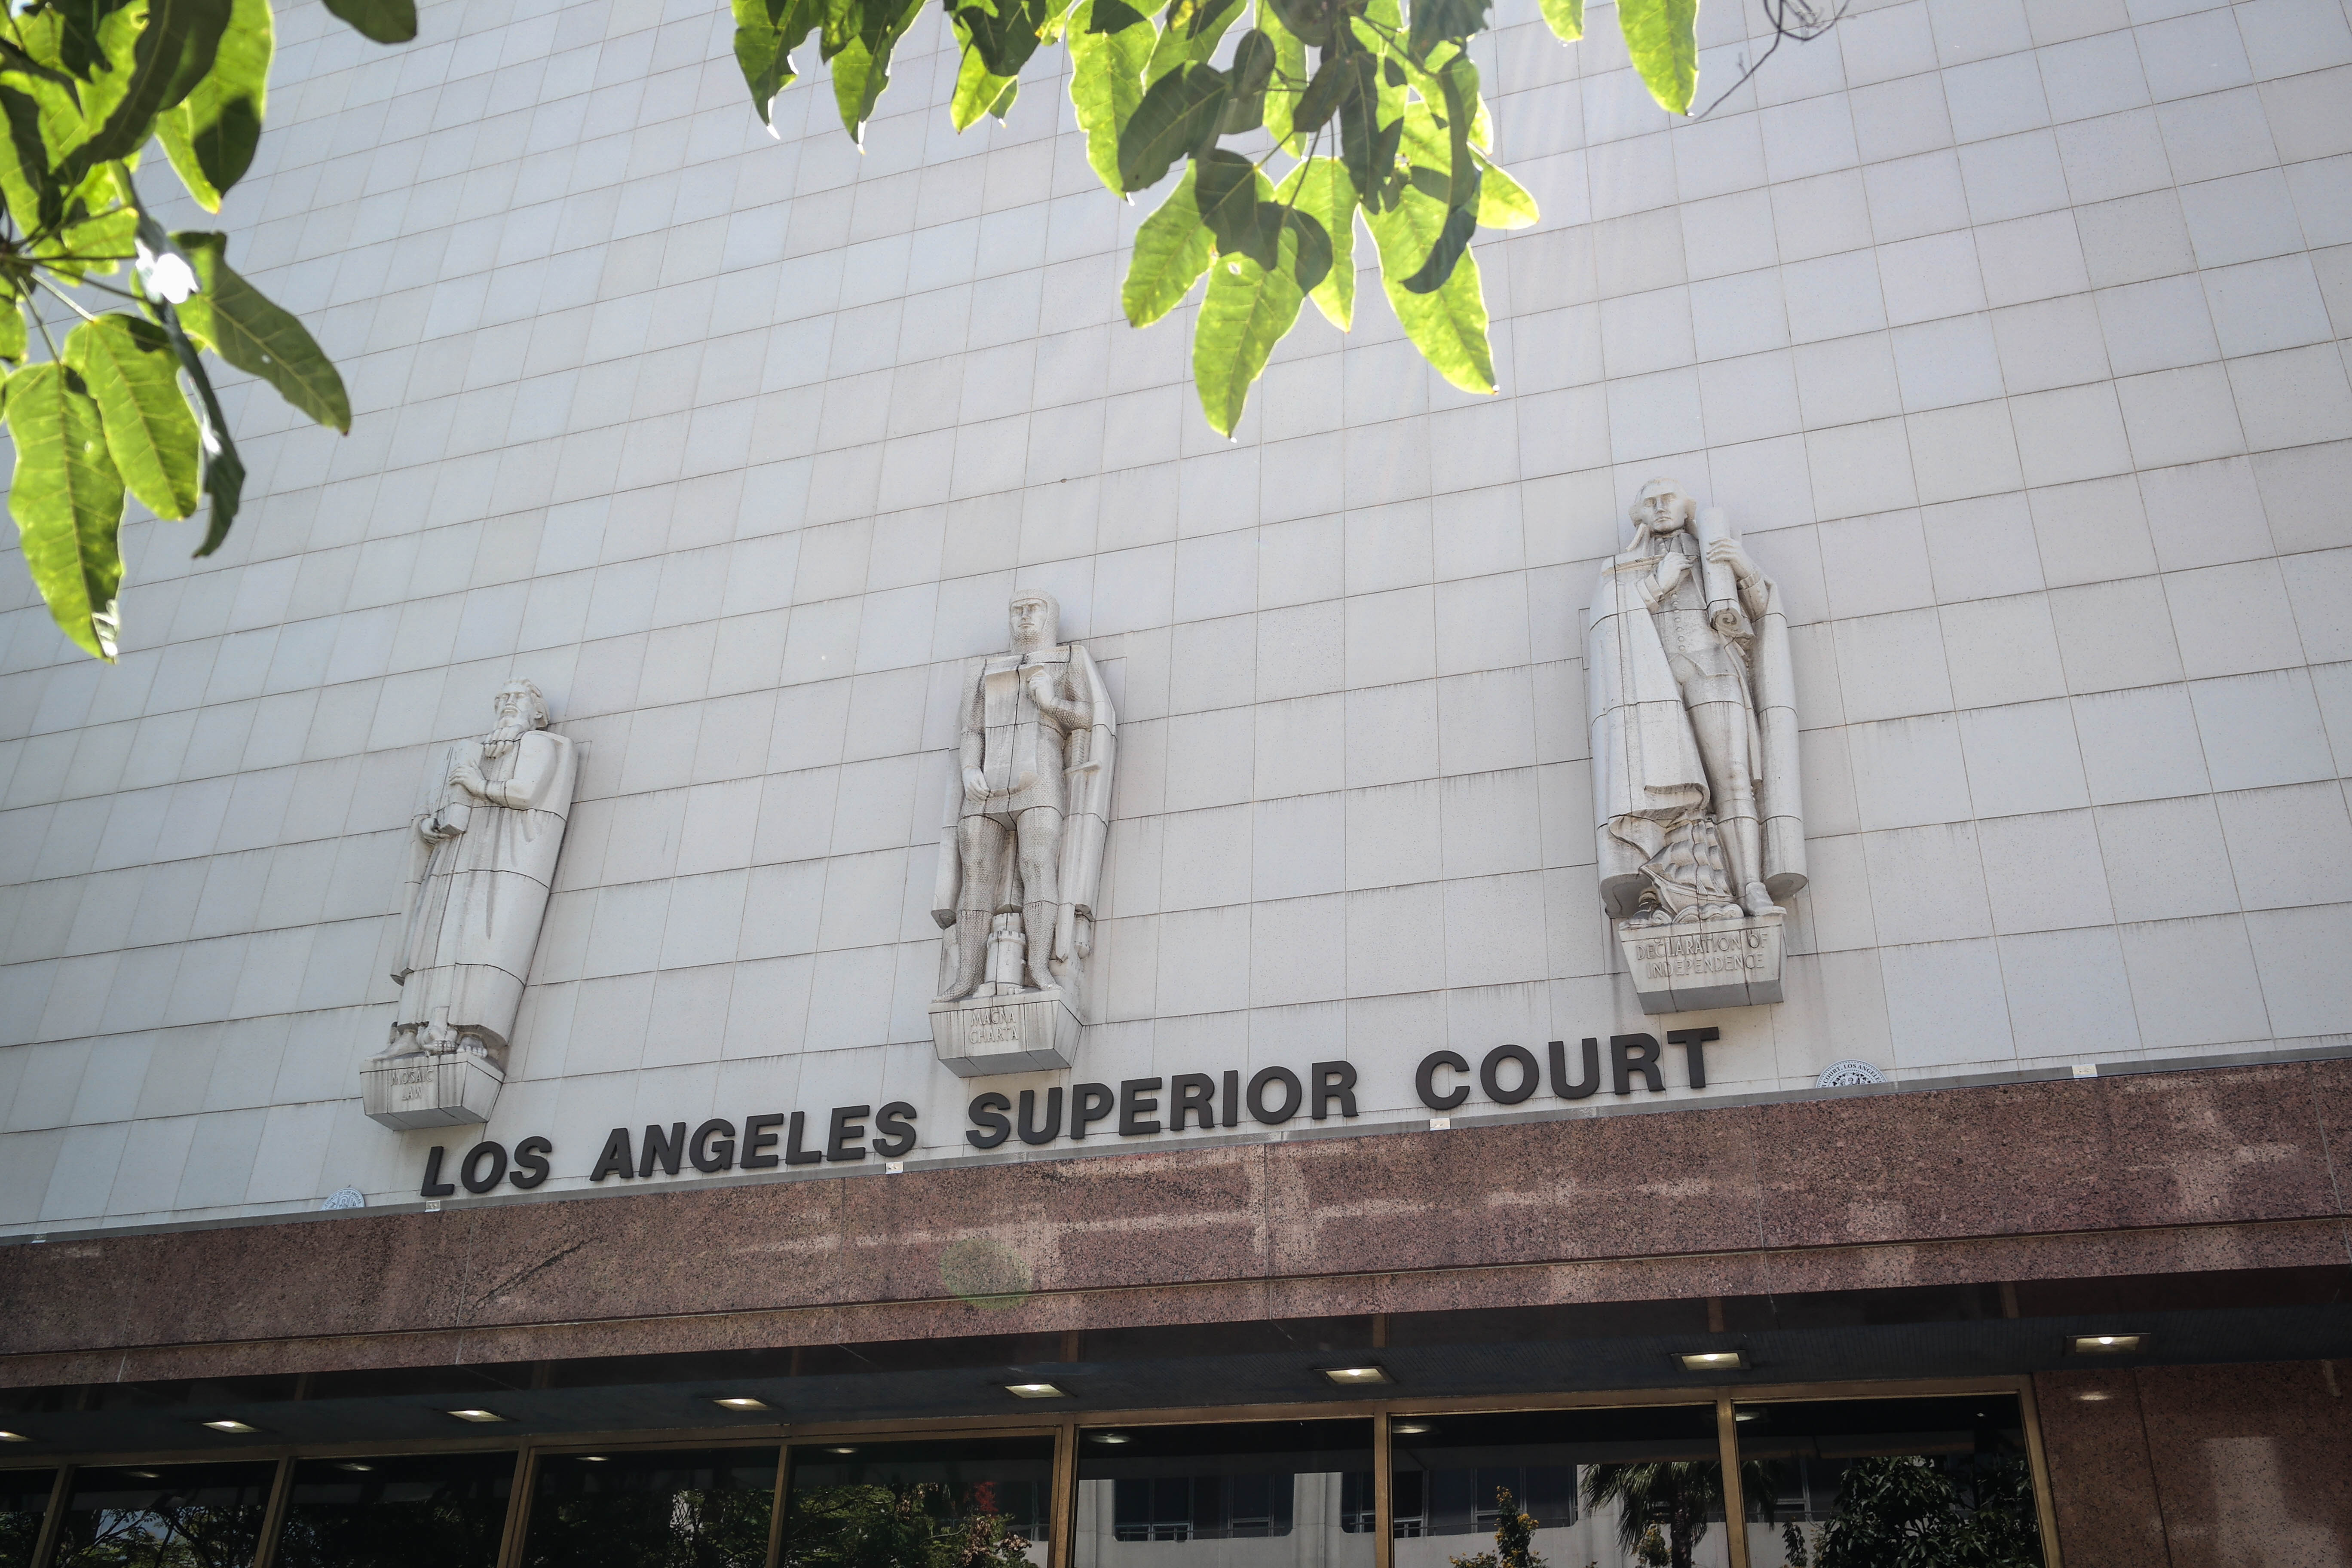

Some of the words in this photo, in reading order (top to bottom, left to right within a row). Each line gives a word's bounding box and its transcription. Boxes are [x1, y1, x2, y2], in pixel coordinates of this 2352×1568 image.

[1636, 935, 1742, 960] DECLARATION
[1748, 933, 1767, 949] OF
[1647, 953, 1765, 979] INDEPENDENCE
[971, 1010, 1017, 1027] MAGNA
[970, 1026, 1019, 1044] CHARTA
[391, 1069, 434, 1087] MOSAIC
[402, 1086, 423, 1101] LAW
[420, 1136, 552, 1197] LOS
[590, 1101, 917, 1181] ANGELES
[966, 1060, 1361, 1149] SUPERIOR
[1415, 1026, 1721, 1111] COURT
